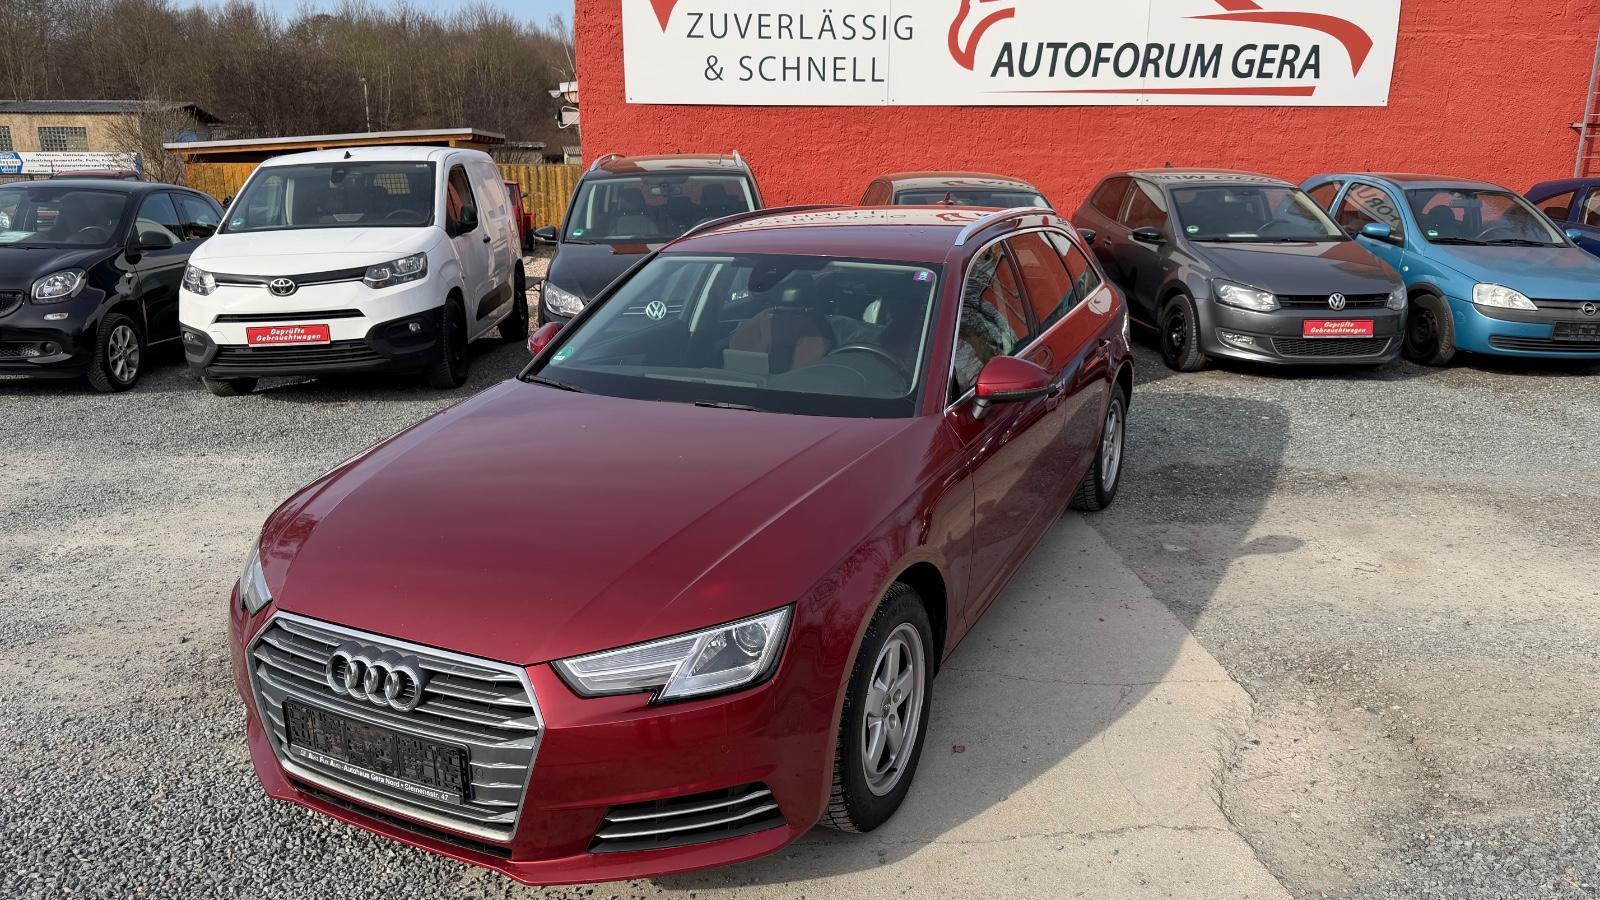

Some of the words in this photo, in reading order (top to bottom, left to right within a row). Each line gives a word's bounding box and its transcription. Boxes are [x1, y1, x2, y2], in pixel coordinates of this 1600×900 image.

[686, 9, 913, 41] ZUVERLÄSSIG
[704, 55, 724, 81] &
[739, 55, 885, 82] SCHNELL
[990, 41, 1223, 79] AUTOFORUM
[1231, 43, 1321, 79] GERA
[256, 334, 321, 342] Gebrauchtwagen
[270, 327, 305, 335] Geprüfte
[386, 777, 400, 788] Nord
[441, 793, 449, 801] 47
